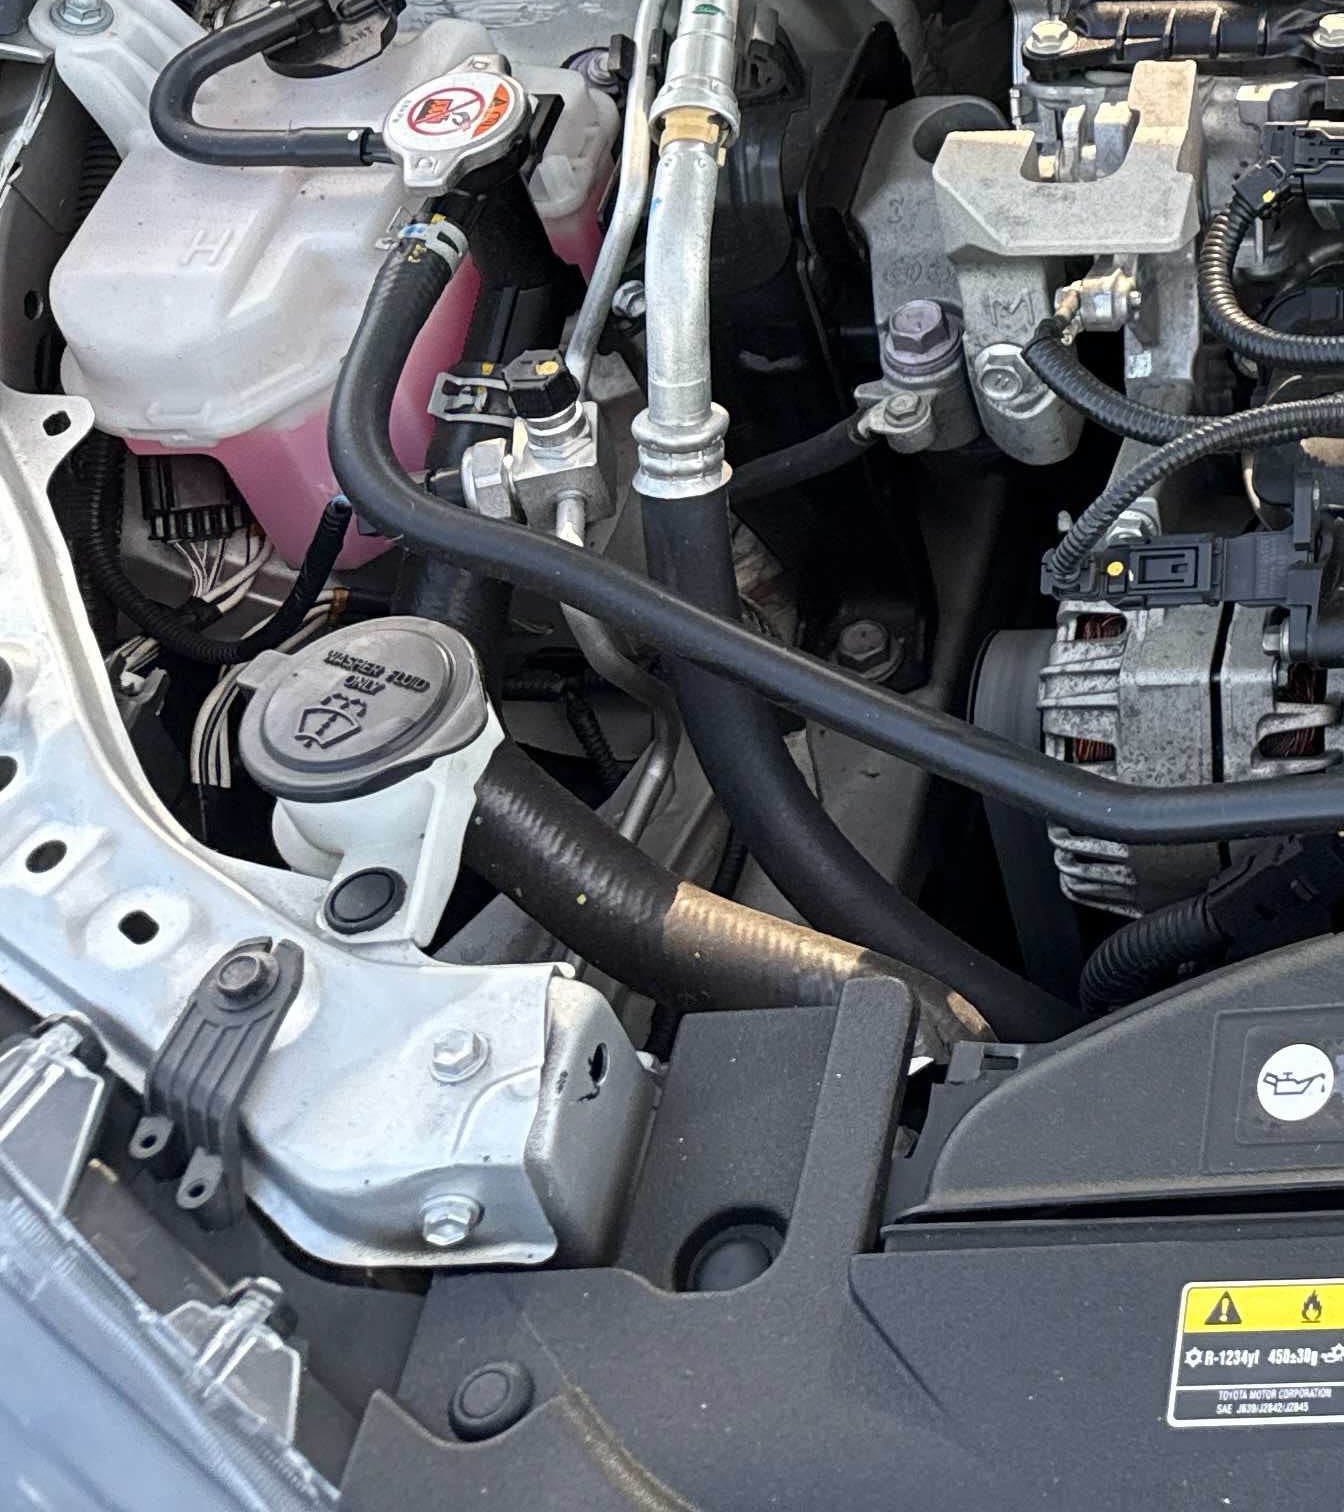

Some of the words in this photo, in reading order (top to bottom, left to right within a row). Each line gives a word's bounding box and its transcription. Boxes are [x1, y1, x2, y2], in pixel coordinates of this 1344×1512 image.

[323, 650, 386, 678] WASHER
[385, 670, 431, 693] FLUID
[344, 675, 386, 696] ONLY
[1218, 1390, 1248, 1401] TOYOTA
[1249, 1389, 1277, 1400] MOTOR
[1278, 1388, 1332, 1400] CORPORATION
[1215, 1403, 1233, 1415] SAE
